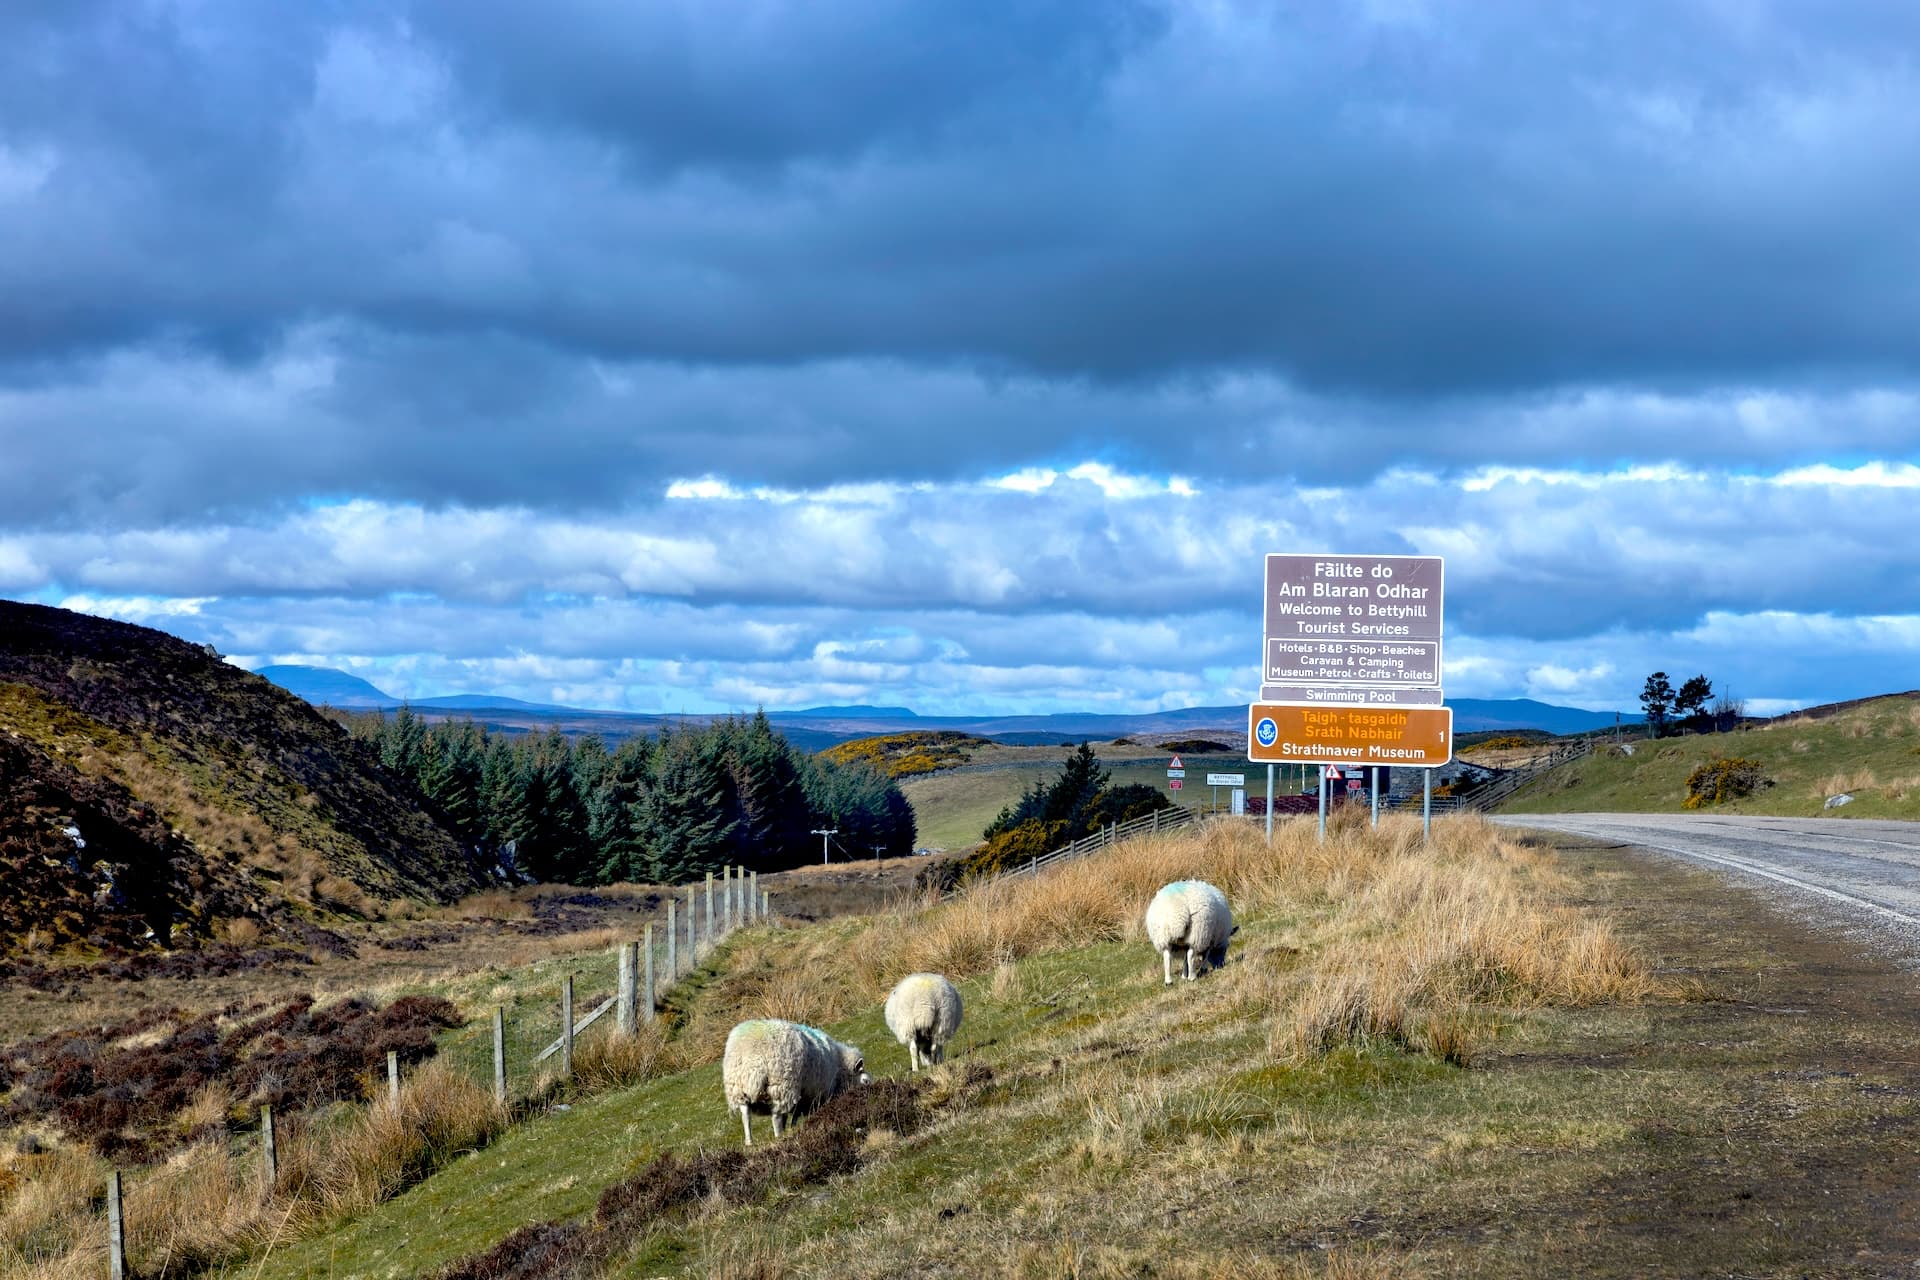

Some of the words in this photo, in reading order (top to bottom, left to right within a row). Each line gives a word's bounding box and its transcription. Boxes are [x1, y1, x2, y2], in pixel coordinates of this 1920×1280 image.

[1371, 564, 1393, 578] do
[1279, 582, 1306, 597] Am
[1313, 582, 1369, 598] Blaran
[1376, 583, 1429, 599] Odhar
[1279, 603, 1342, 616] Welcome
[1348, 604, 1363, 616] to
[1368, 604, 1428, 619] Bettyhill
[1296, 621, 1345, 634] Tourist
[1351, 622, 1409, 635] Services
[1279, 643, 1313, 653] Hotels
[1319, 644, 1343, 654] B&B
[1349, 645, 1377, 656] Shop
[1382, 645, 1426, 656] Beaches
[1300, 656, 1343, 666] Caravan
[1346, 656, 1355, 666] &
[1358, 657, 1404, 668] Camping
[1271, 667, 1314, 677] Museum
[1319, 668, 1352, 678] Petrol
[1358, 669, 1391, 679] Crafts
[1397, 669, 1433, 680] Toilets
[1306, 689, 1365, 702] Swimming
[1369, 691, 1396, 702] Pool
[1305, 726, 1344, 739] Srath
[1349, 727, 1404, 740] Nabhair
[1438, 730, 1445, 743] 1
[1282, 742, 1363, 757] Strathnaver
[1369, 745, 1425, 759] Museum
